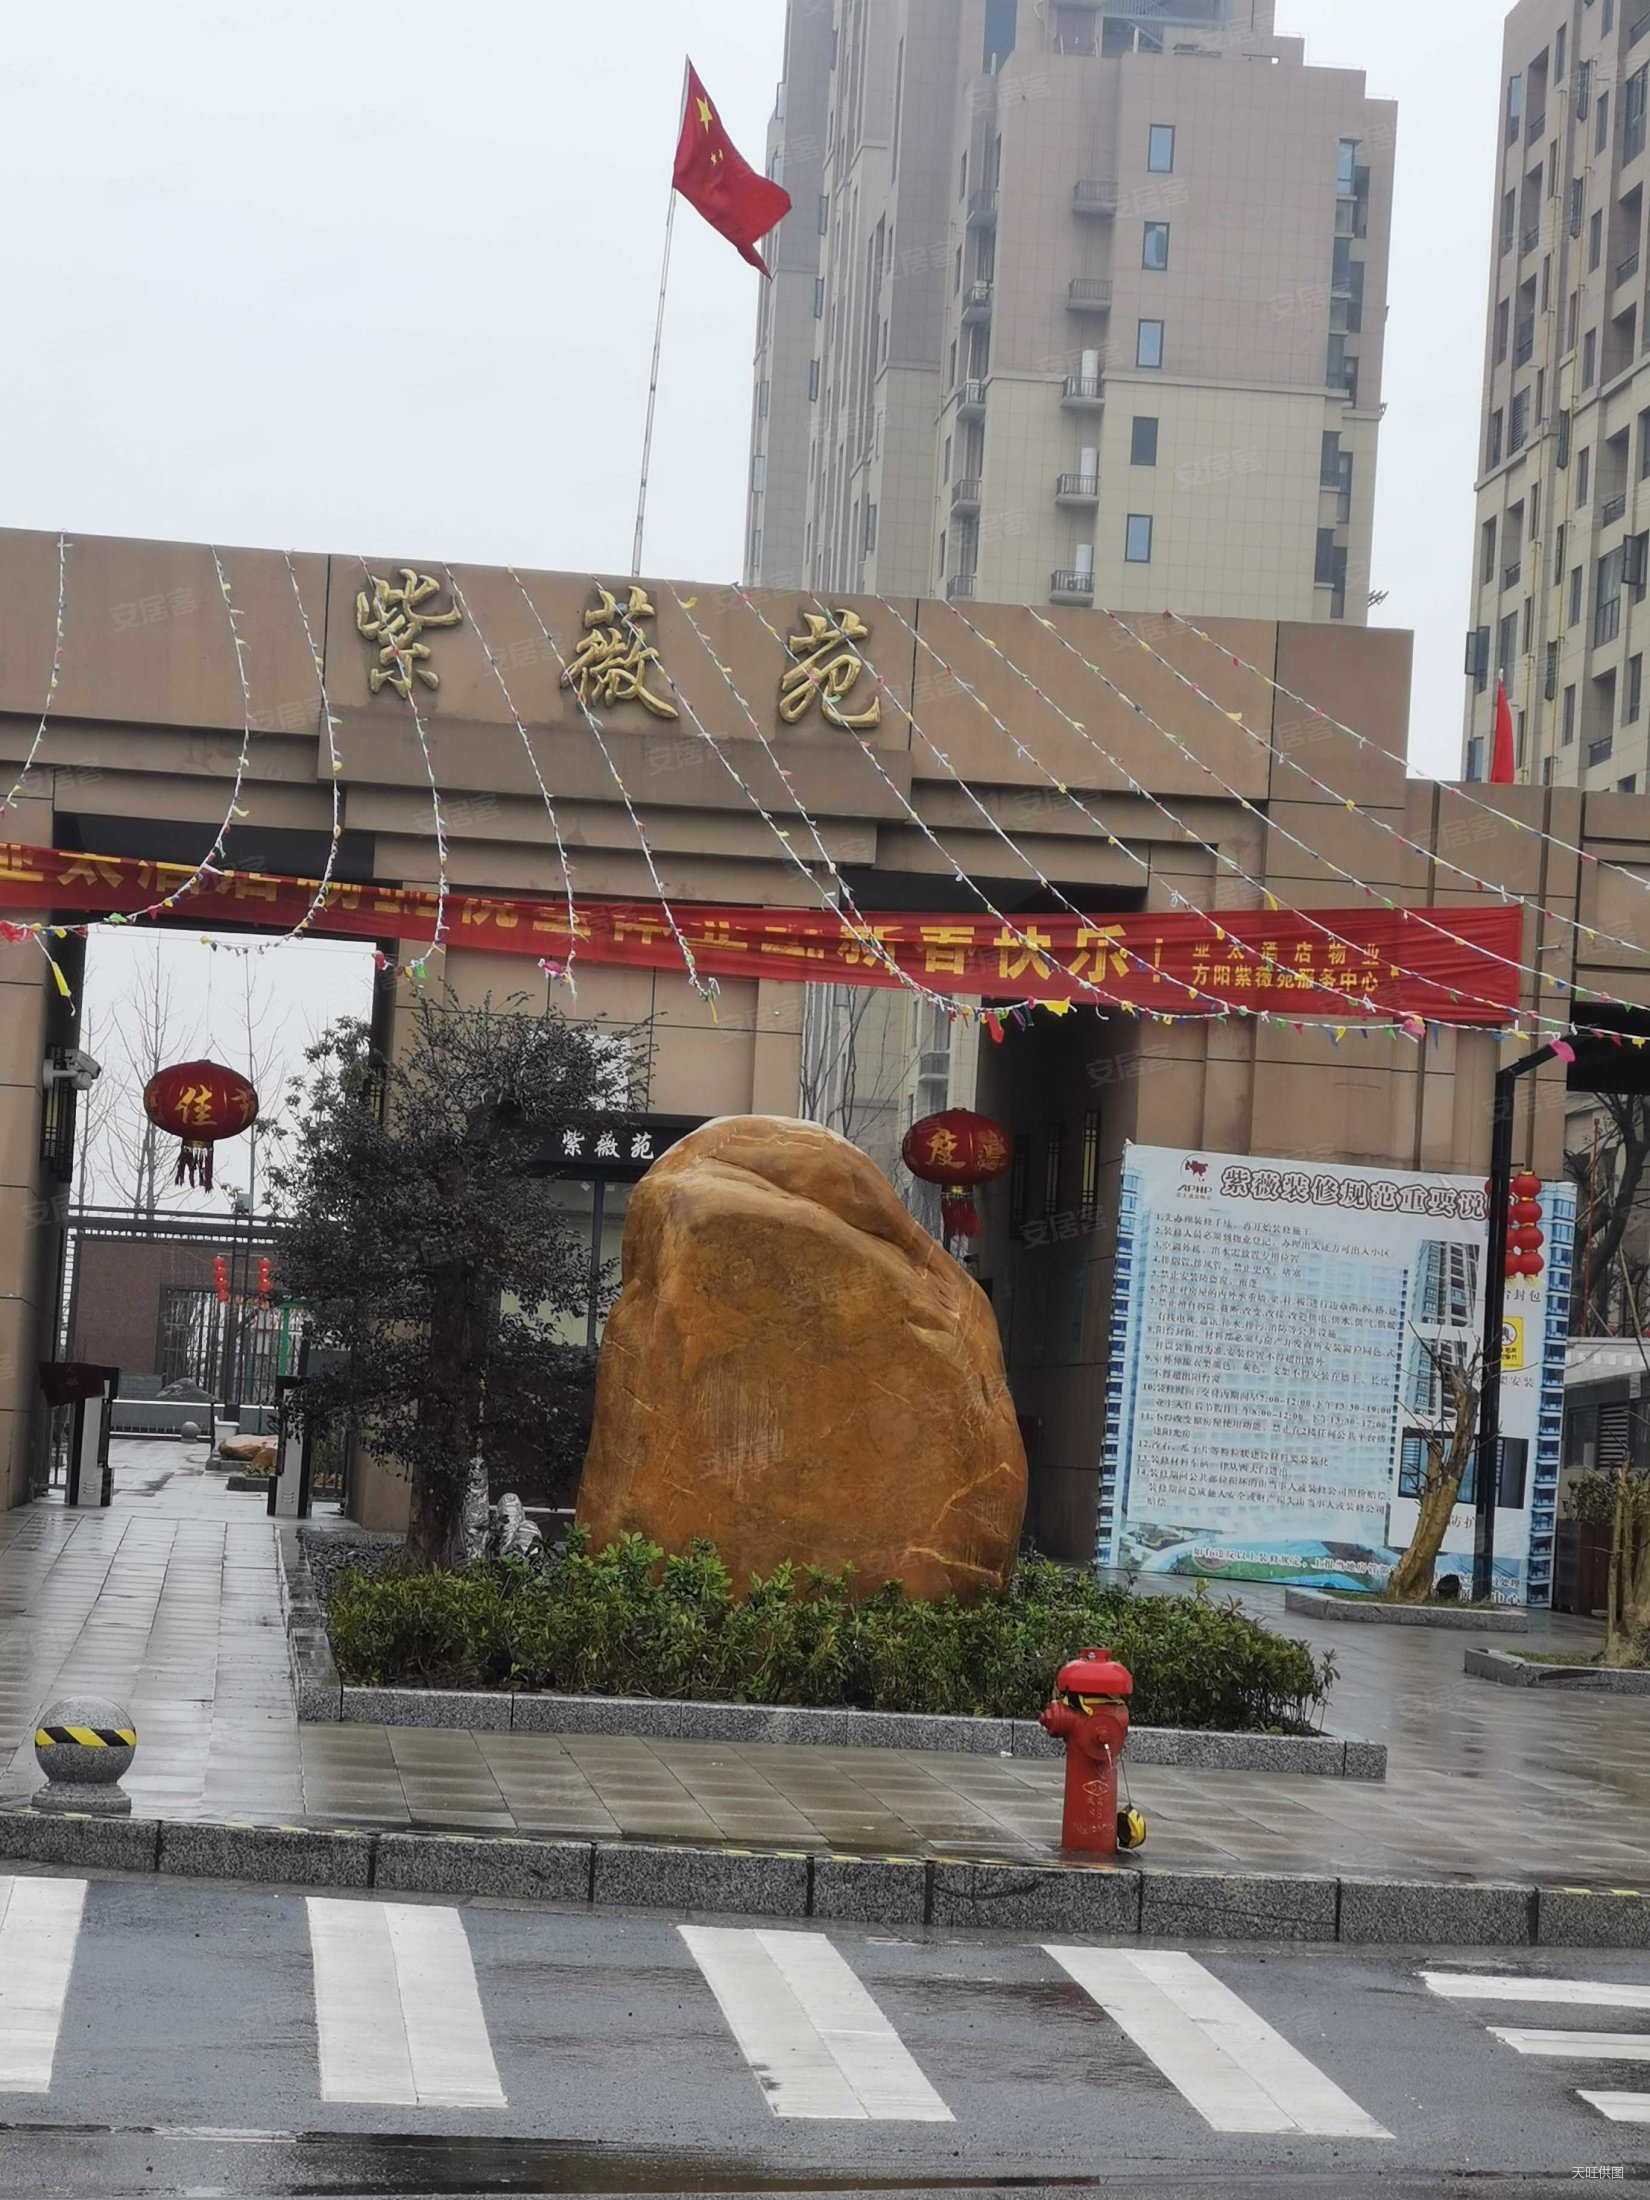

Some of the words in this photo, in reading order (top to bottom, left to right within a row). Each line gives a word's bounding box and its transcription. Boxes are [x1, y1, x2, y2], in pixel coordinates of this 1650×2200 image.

[356, 567, 882, 729] 紫薇苑
[1192, 940, 1380, 966] 亚太酒店物业
[561, 1129, 656, 1160] 紫薇苑
[1177, 1183, 1214, 1195] APHP
[1220, 1165, 1512, 1222] 紫薇装修规范重要说
